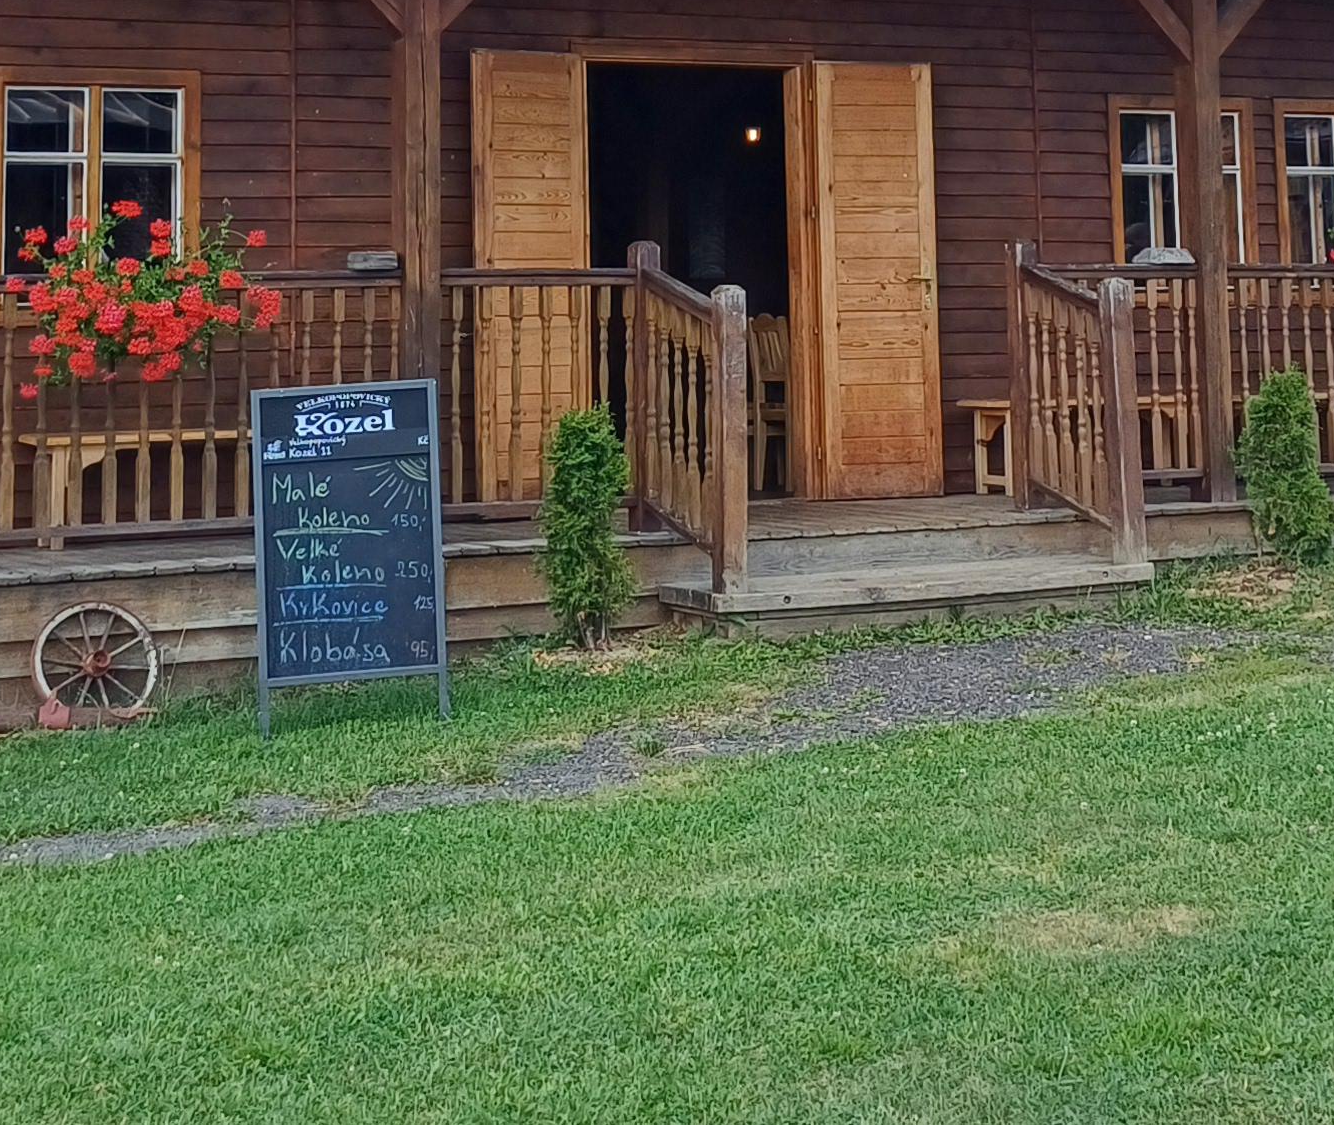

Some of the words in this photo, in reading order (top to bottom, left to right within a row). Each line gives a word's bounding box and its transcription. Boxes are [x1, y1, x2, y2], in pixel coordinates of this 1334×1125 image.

[294, 409, 395, 436] Kozel
[289, 446, 317, 458] Kozel
[321, 446, 332, 455] 11
[418, 435, 429, 445] Kč
[272, 472, 331, 504] Malé
[298, 507, 370, 531] Koleno
[276, 539, 342, 560] Velké
[302, 560, 385, 584] Koleno
[280, 627, 390, 664] Klobása
